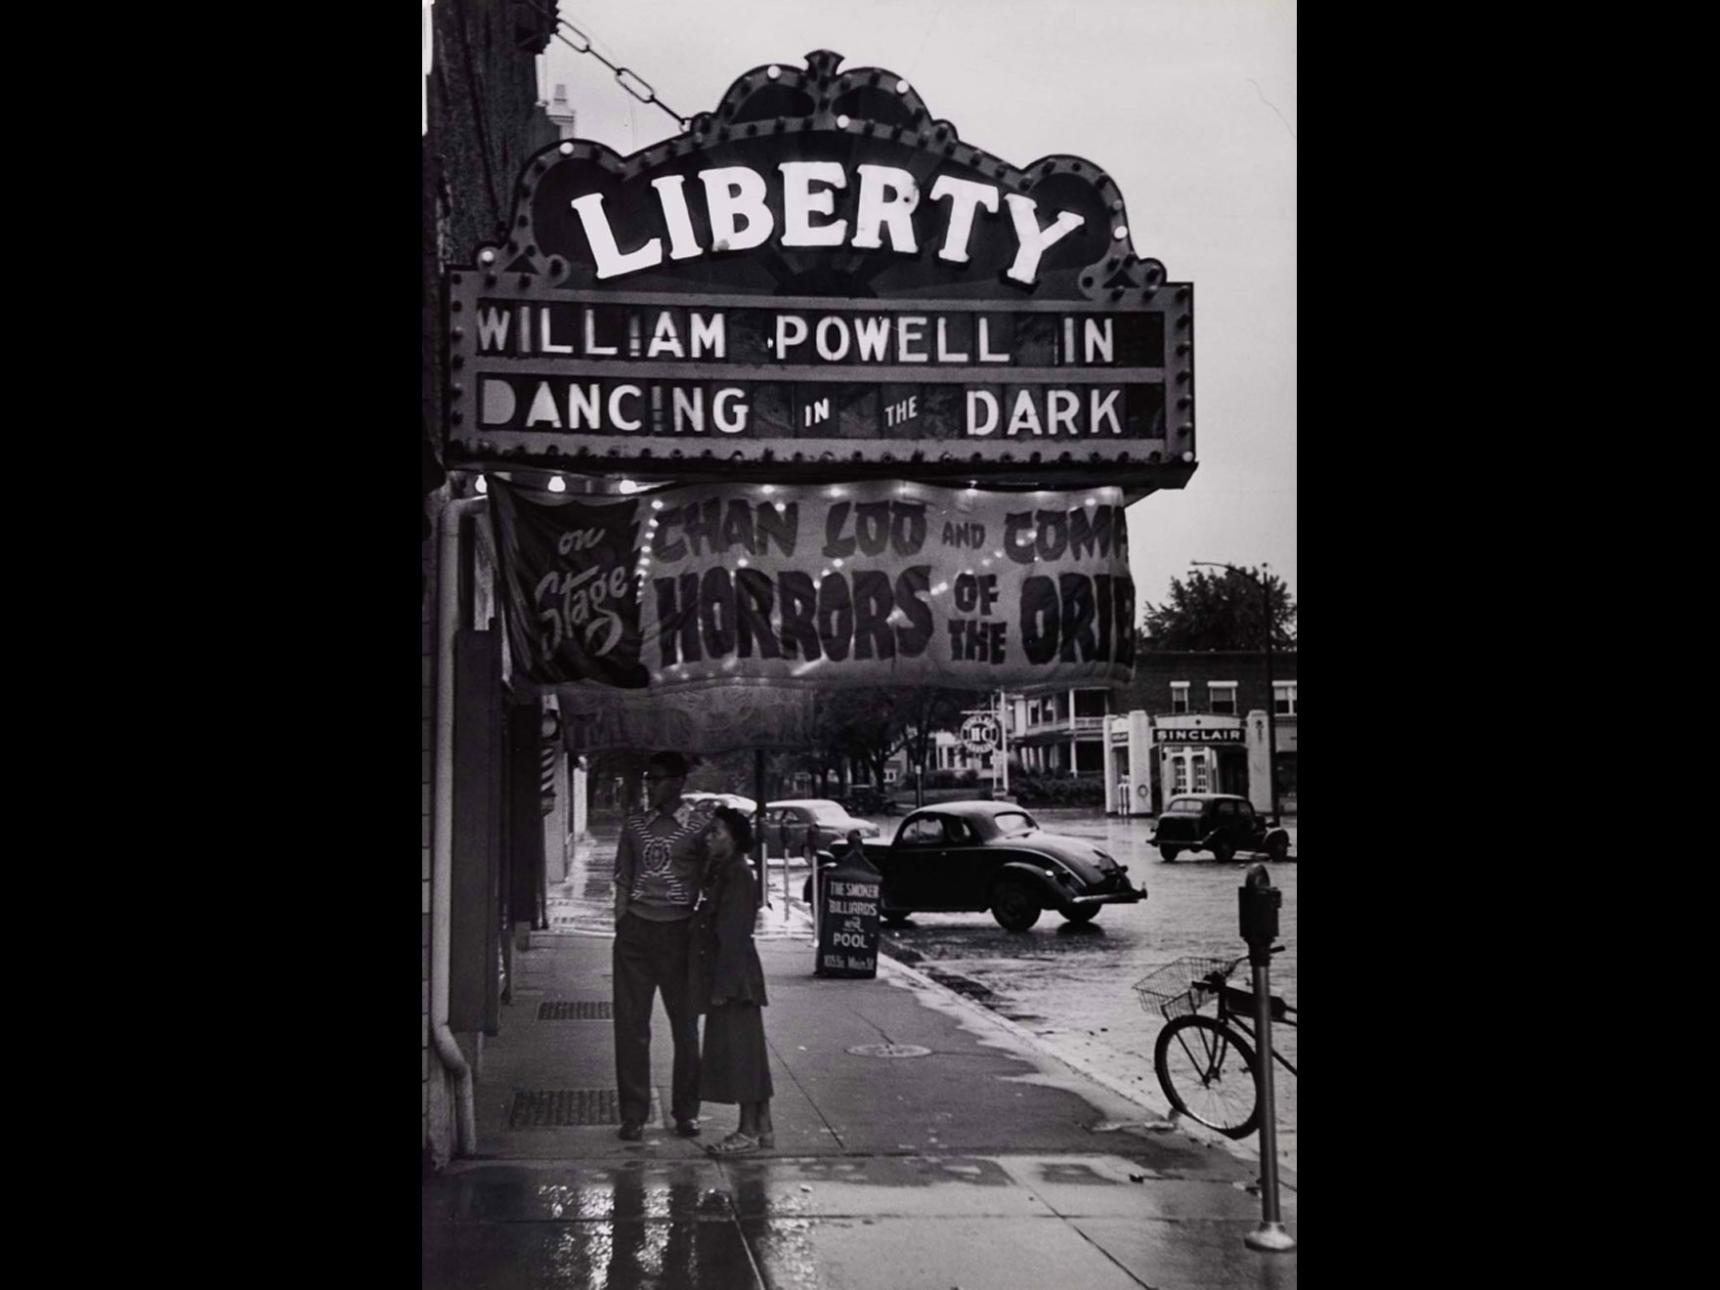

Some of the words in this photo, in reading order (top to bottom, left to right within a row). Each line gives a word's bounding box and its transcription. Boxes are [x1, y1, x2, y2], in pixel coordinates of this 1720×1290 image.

[571, 161, 1084, 284] LIBERTY
[477, 306, 726, 358] WILLIAM
[776, 315, 1010, 362] POWELL
[1064, 317, 1114, 363] IN
[482, 379, 749, 433] DANCING
[804, 398, 830, 427] IN
[885, 396, 917, 427] THE
[966, 389, 1122, 436] DARK
[651, 499, 799, 565] CHAN
[822, 500, 927, 558] LOO
[942, 521, 985, 549] AND
[534, 565, 628, 661] Stage
[653, 565, 934, 667] HORRORS
[954, 572, 998, 616] OF
[948, 619, 1006, 664] THE
[1157, 729, 1240, 740] SINCLAIR
[828, 900, 877, 916] BILLIARDS
[833, 932, 868, 948] POOL
